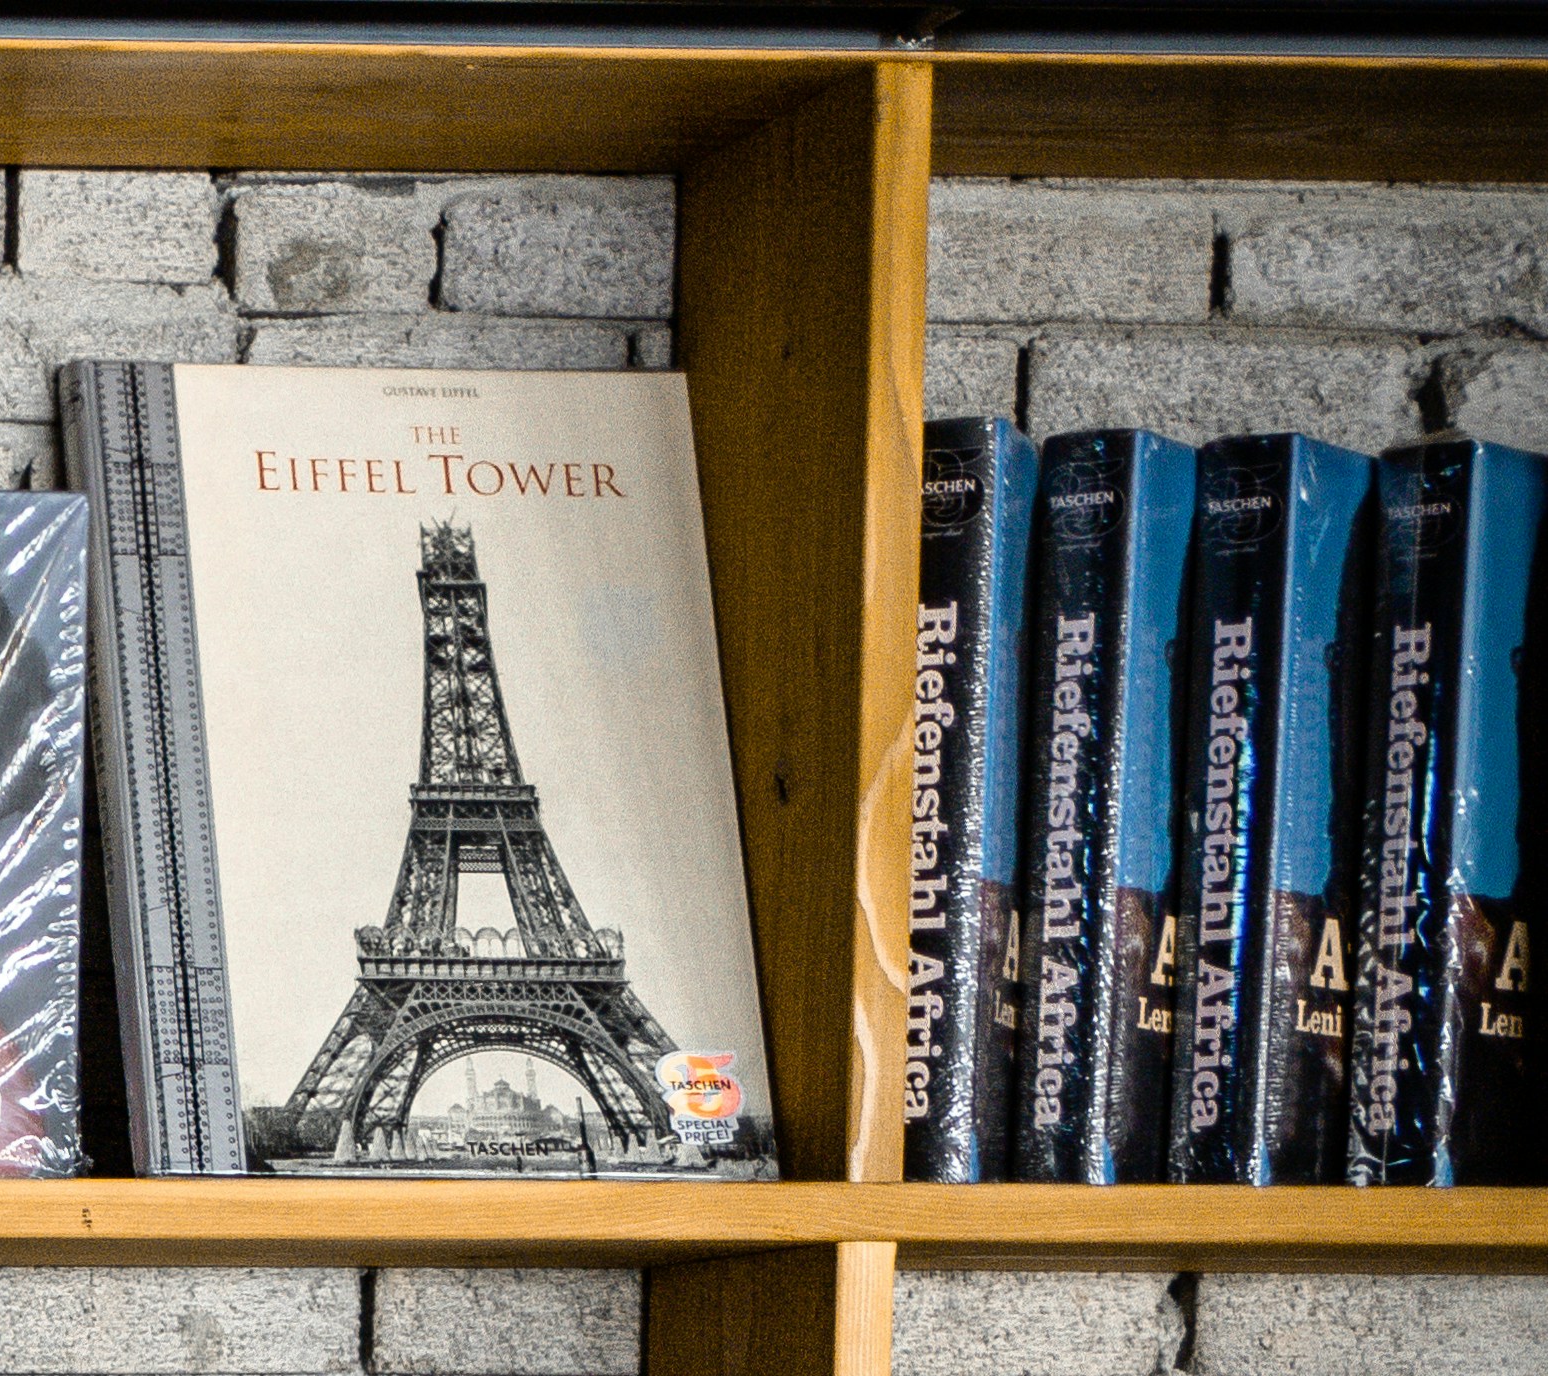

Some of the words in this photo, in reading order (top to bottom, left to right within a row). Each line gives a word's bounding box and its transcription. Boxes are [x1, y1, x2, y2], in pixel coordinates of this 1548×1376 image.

[382, 386, 436, 398] GUSTAVE
[409, 424, 462, 445] THE
[255, 449, 417, 494] EIFFEL
[426, 453, 626, 498] TOWER
[1199, 617, 1252, 946] Riefenstahl
[1191, 958, 1235, 1133] Africa
